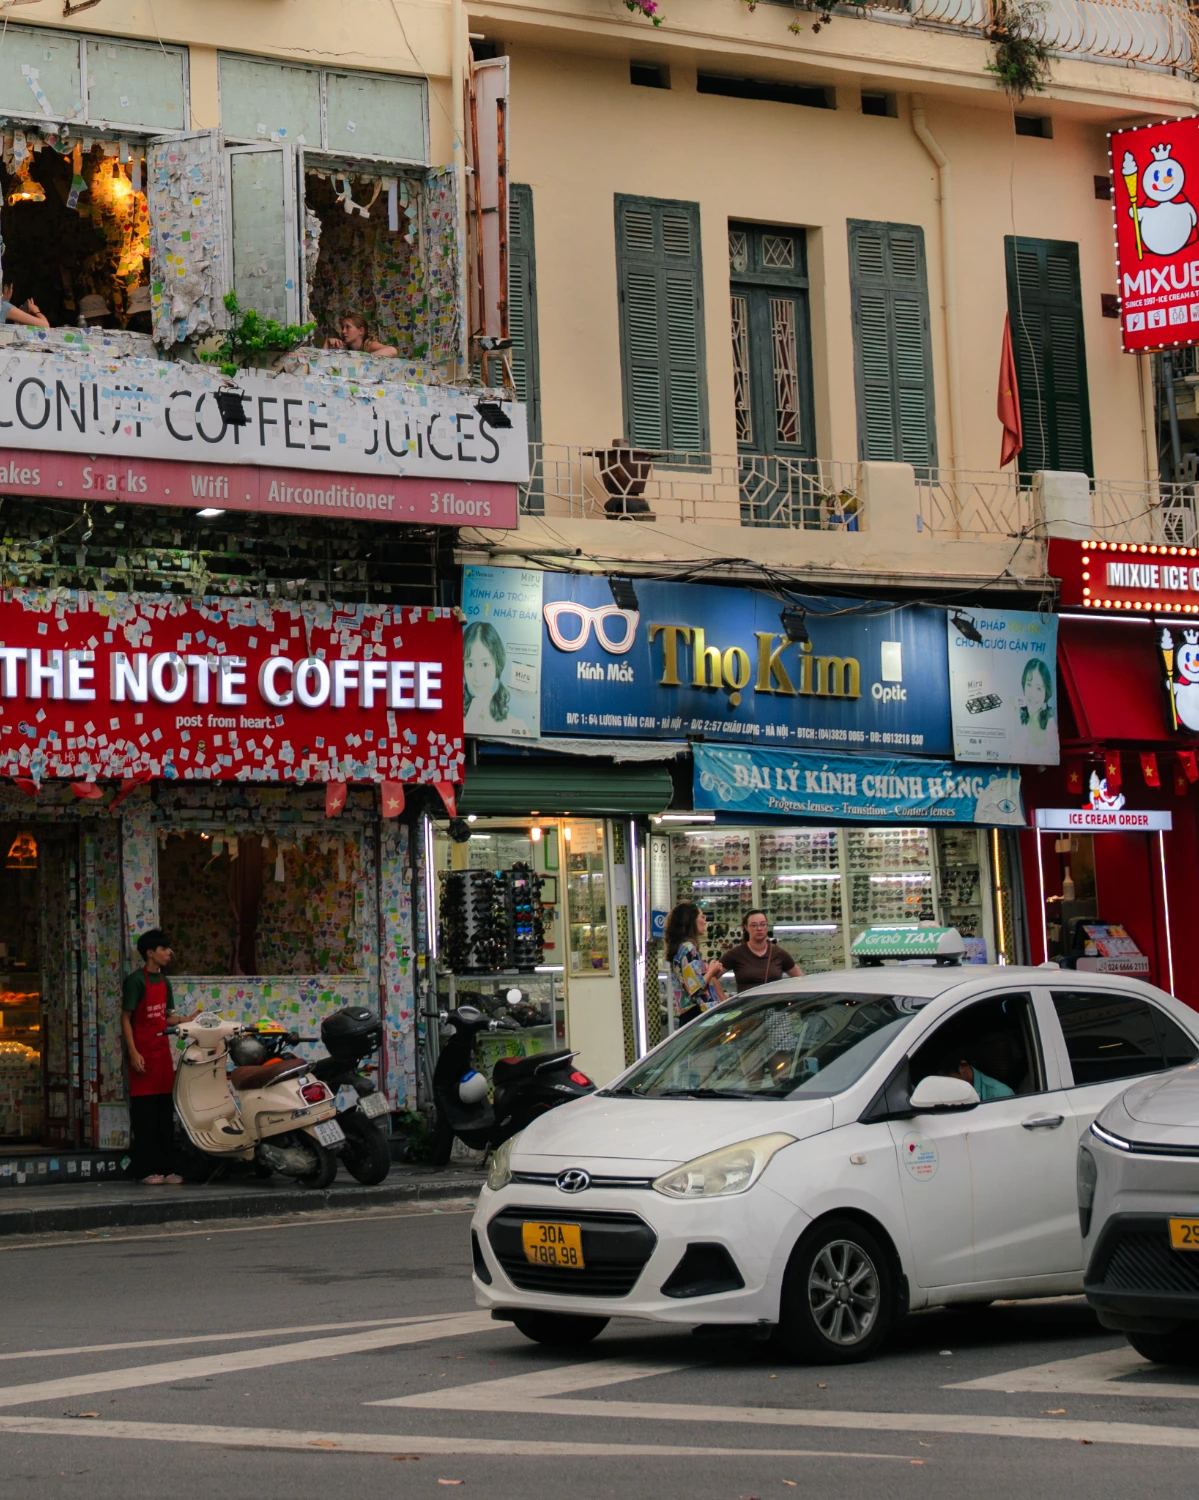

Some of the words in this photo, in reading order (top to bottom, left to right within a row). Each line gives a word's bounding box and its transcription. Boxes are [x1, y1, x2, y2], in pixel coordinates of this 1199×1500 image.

[164, 389, 331, 451] COFFEE
[364, 405, 500, 464] JUICES
[82, 466, 148, 493] Snacks
[190, 474, 229, 499] Wifi
[268, 480, 395, 511] Airconditioner
[520, 571, 541, 583] Miru
[1106, 562, 1160, 589] MIXUE
[1160, 565, 1189, 591] ICE
[469, 587, 491, 599] KÍNH
[492, 588, 505, 600] ÁP
[468, 603, 480, 616] SỐ
[493, 607, 517, 621] NHẬT
[980, 620, 1006, 631] PHÁP
[1008, 641, 1028, 654] CẬN
[576, 661, 605, 680] Kính
[606, 660, 634, 683] Mắt
[648, 624, 751, 707] Thọ
[753, 631, 862, 699] Kim
[109, 650, 247, 705] NOTE
[257, 655, 443, 710] COFFEE
[515, 670, 531, 681] Miru
[967, 680, 983, 689] Miru
[871, 682, 907, 703] Optic
[175, 715, 202, 729] post
[207, 714, 236, 728] from
[240, 715, 275, 729] heart.
[623, 713, 638, 727] VĂN
[639, 716, 655, 729] CAN
[765, 722, 775, 736] HÀ
[734, 763, 770, 793] ĐẠI
[775, 761, 799, 793] LÝ
[804, 764, 857, 796] KÍNH
[861, 768, 923, 799] CHÍNH
[928, 771, 984, 799] HÃNG
[768, 794, 805, 812] Progress
[806, 799, 834, 813] lenses
[842, 802, 887, 817] Transition
[894, 805, 928, 817] Contact
[929, 804, 956, 817] lenses
[1069, 813, 1083, 825] ICE
[1085, 813, 1117, 825] CREAM
[1118, 815, 1149, 826] ORDER
[865, 932, 901, 945] Grab
[1108, 962, 1119, 972] 024
[1119, 962, 1134, 972] 6666
[539, 1225, 565, 1244] 30A
[530, 1244, 578, 1265] 788.98
